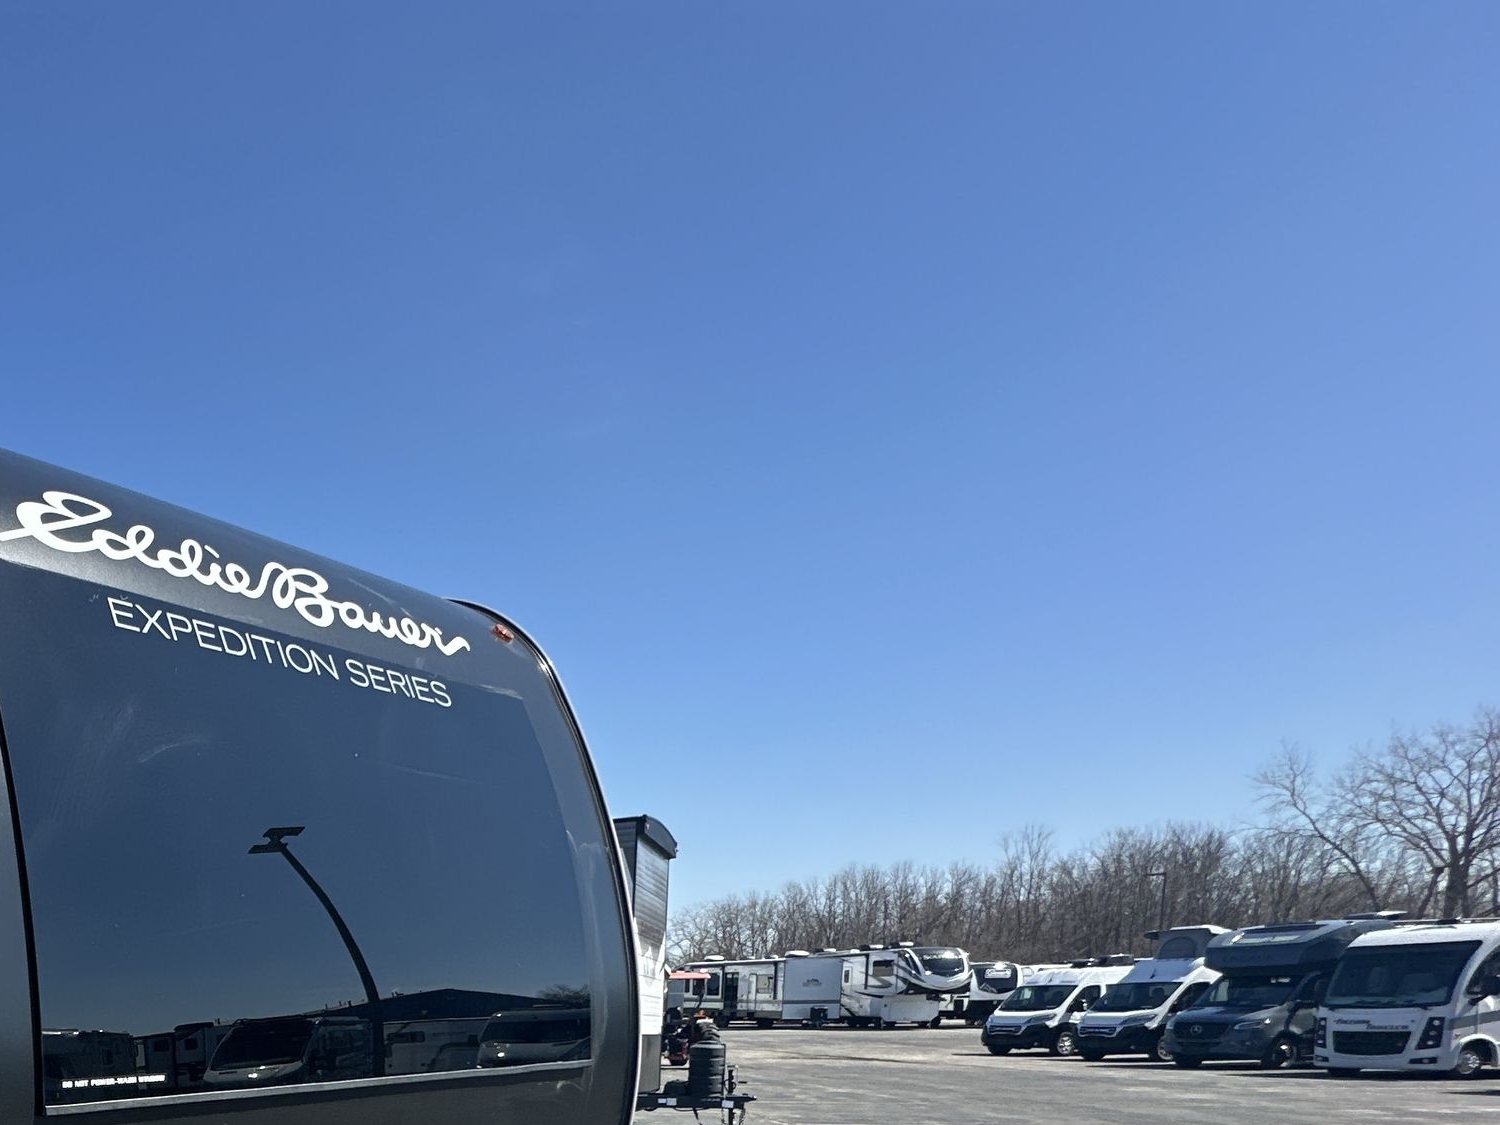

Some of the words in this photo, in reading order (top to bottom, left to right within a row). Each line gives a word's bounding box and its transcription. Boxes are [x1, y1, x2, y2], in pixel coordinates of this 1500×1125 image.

[107, 597, 340, 681] EXPEDITION
[345, 658, 452, 708] SERIES
[256, 561, 471, 656] Bauer
